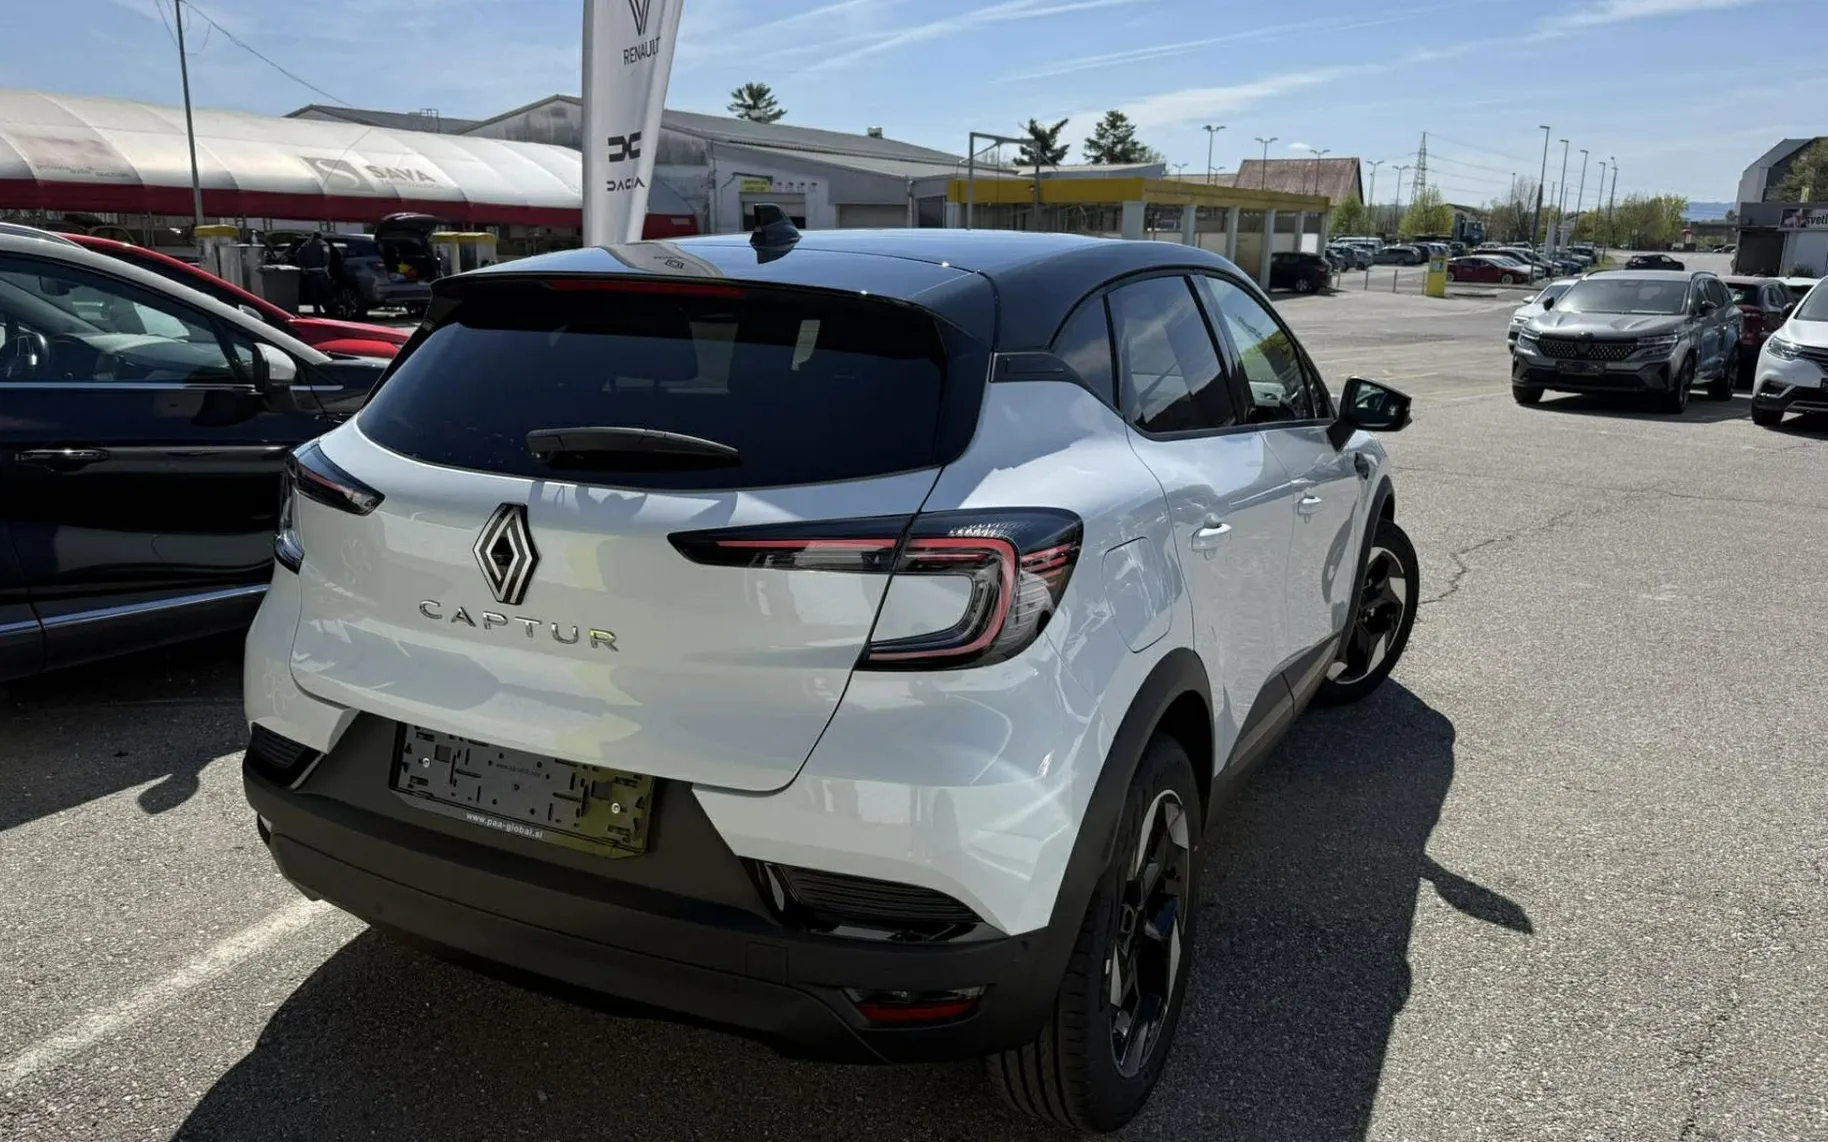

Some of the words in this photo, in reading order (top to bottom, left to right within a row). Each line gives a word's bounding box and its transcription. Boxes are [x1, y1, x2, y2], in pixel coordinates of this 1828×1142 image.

[623, 36, 661, 66] RENAULT
[364, 165, 437, 183] SAVA
[606, 176, 645, 192] DACIA
[419, 599, 619, 652] CAPTUR
